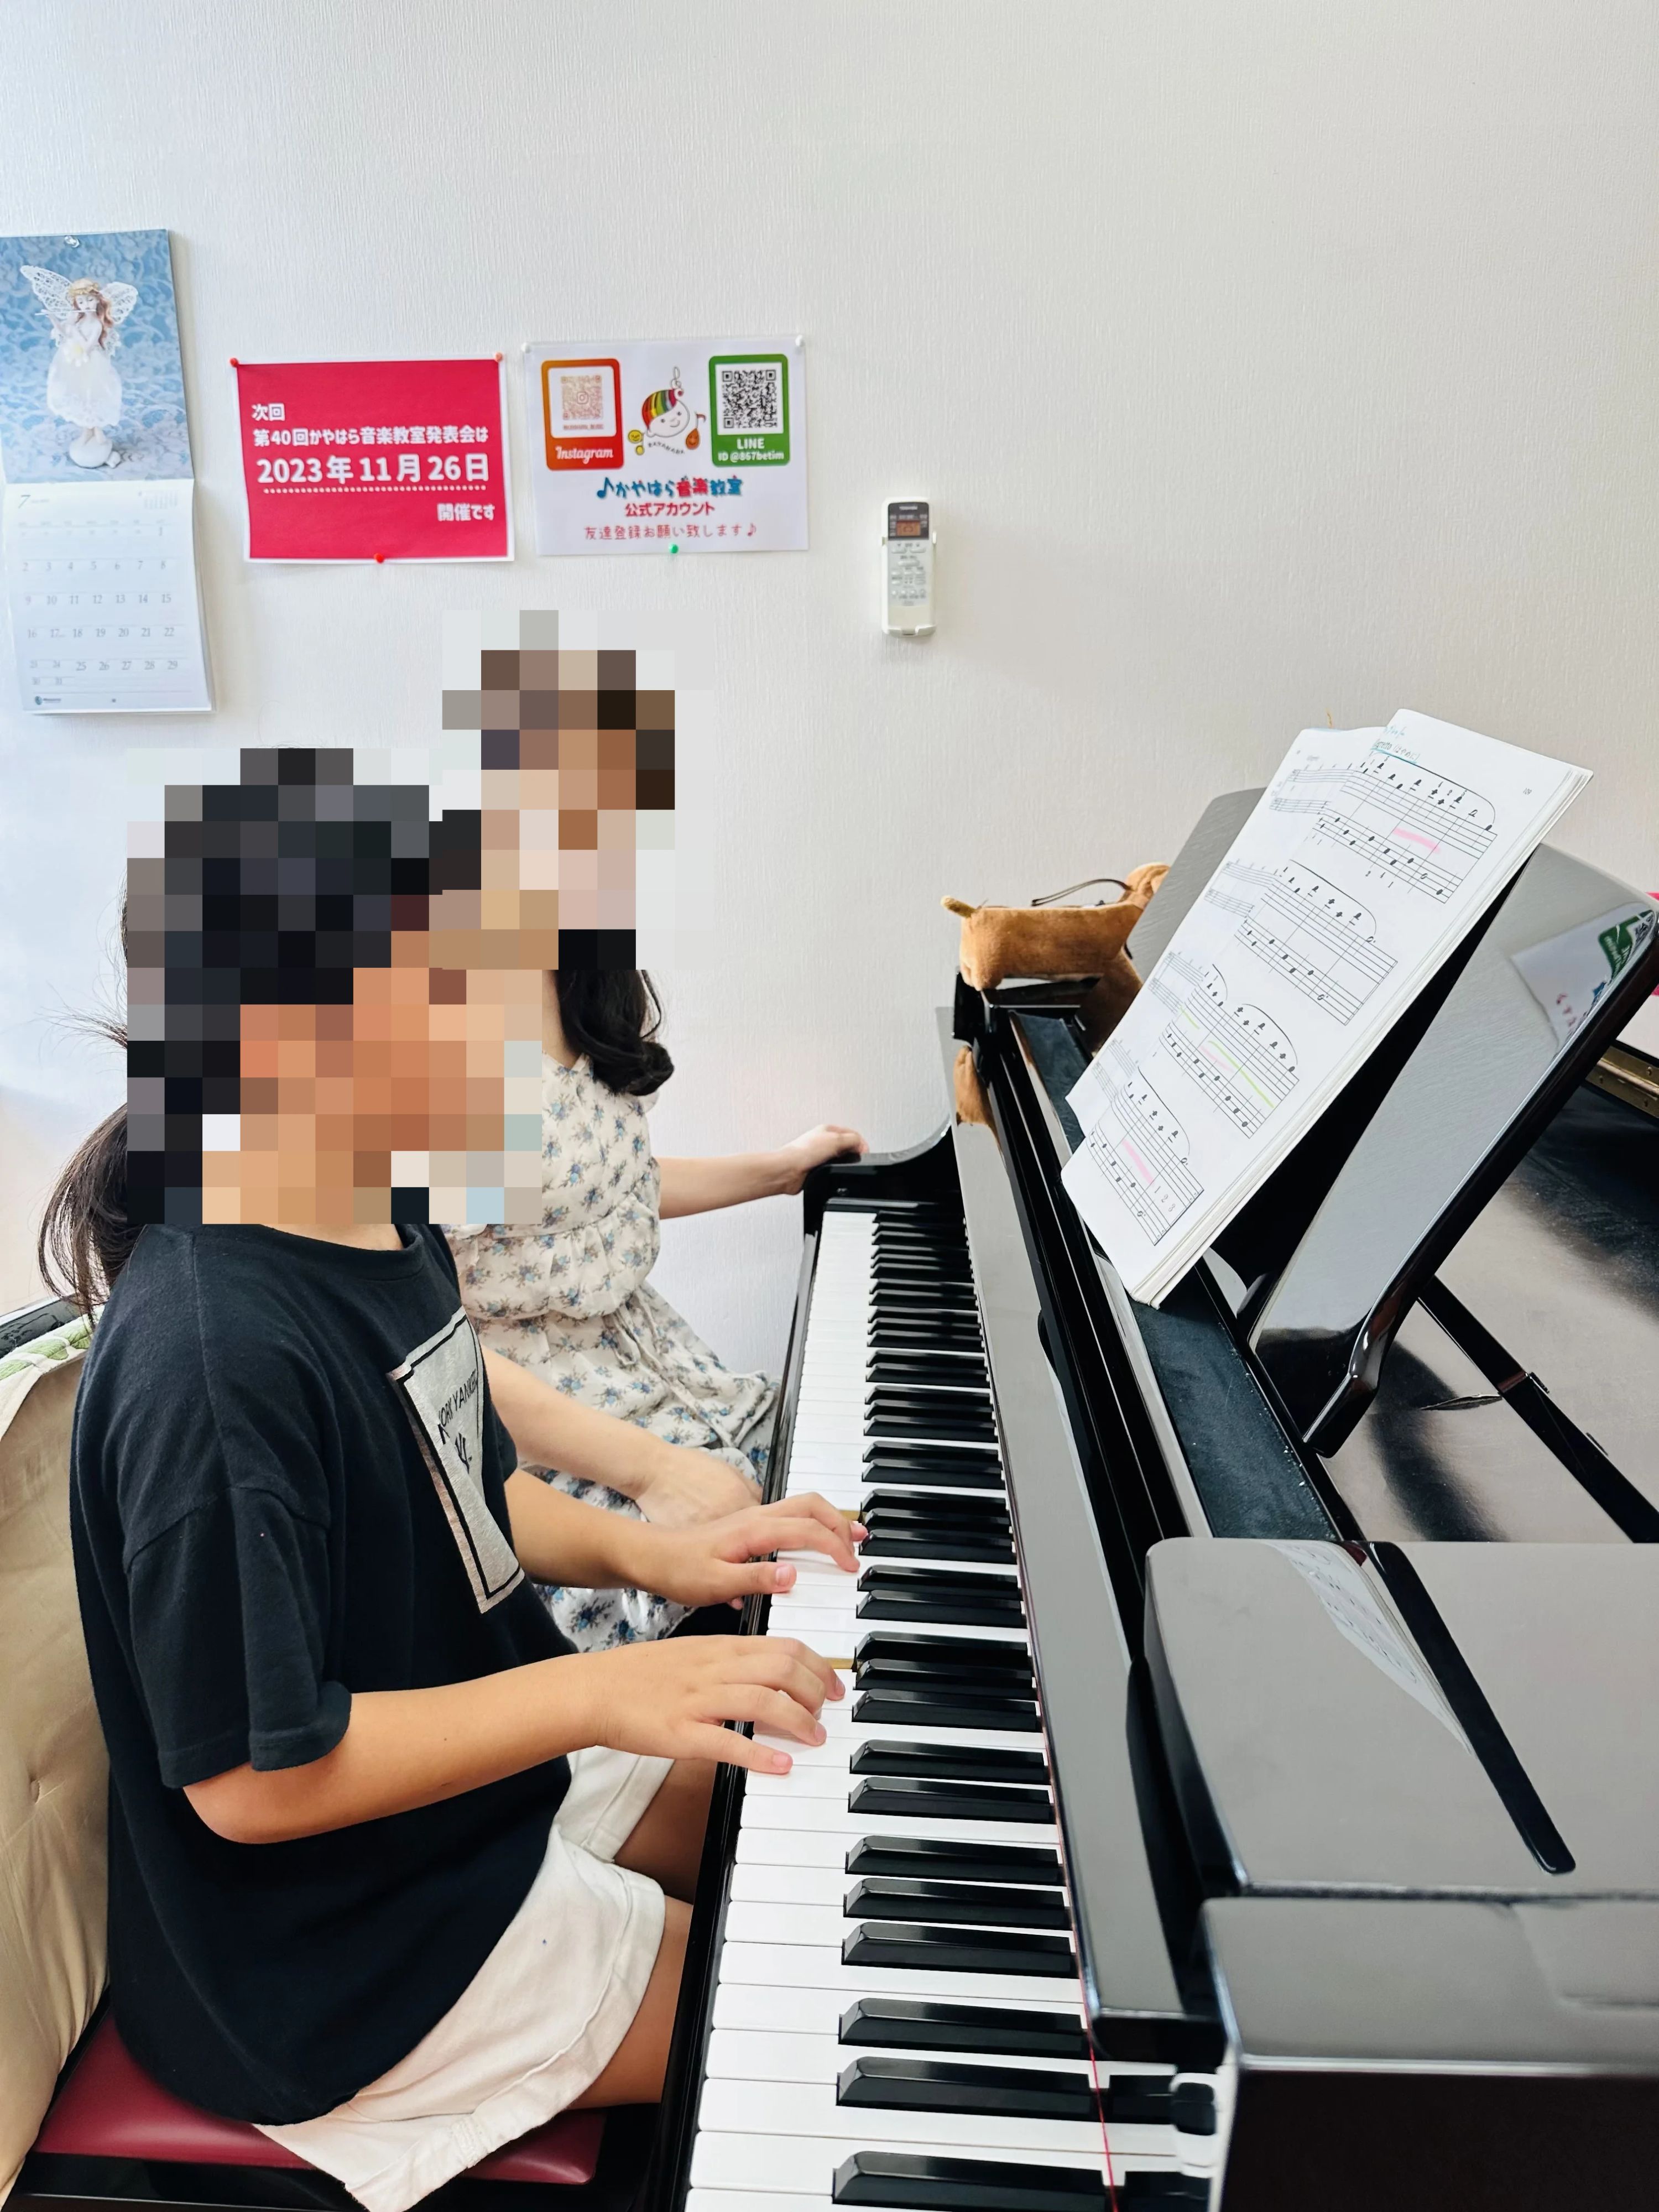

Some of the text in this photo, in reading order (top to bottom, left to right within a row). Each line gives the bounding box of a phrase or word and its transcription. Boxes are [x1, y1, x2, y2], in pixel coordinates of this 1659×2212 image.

[252, 403, 285, 421] 次回
[253, 424, 488, 446] 第40回かやはら音楽教室発表会は
[737, 438, 765, 450] LINE
[555, 446, 614, 465] Instagram
[718, 452, 728, 462] ID
[256, 453, 489, 484] 2023年11月26日
[615, 474, 743, 498] かやはら音楽教室
[18, 494, 30, 509] 7
[437, 503, 495, 522] 開催です
[625, 502, 716, 518] 公式アカウント
[584, 524, 743, 541] 友達登録お願い致します
[22, 560, 166, 571] 2 3 4 5 6 7 8
[25, 594, 171, 606] 9 10 11 12 13 14 15
[28, 628, 175, 638] 16 17 18 19 20 21 22
[76, 662, 86, 671] 25
[99, 662, 109, 670] 26
[122, 661, 131, 670] 27
[144, 661, 155, 670] 28
[168, 661, 178, 669] 29
[1161, 1194, 1168, 1203] 2
[438, 1397, 453, 1427] ORK
